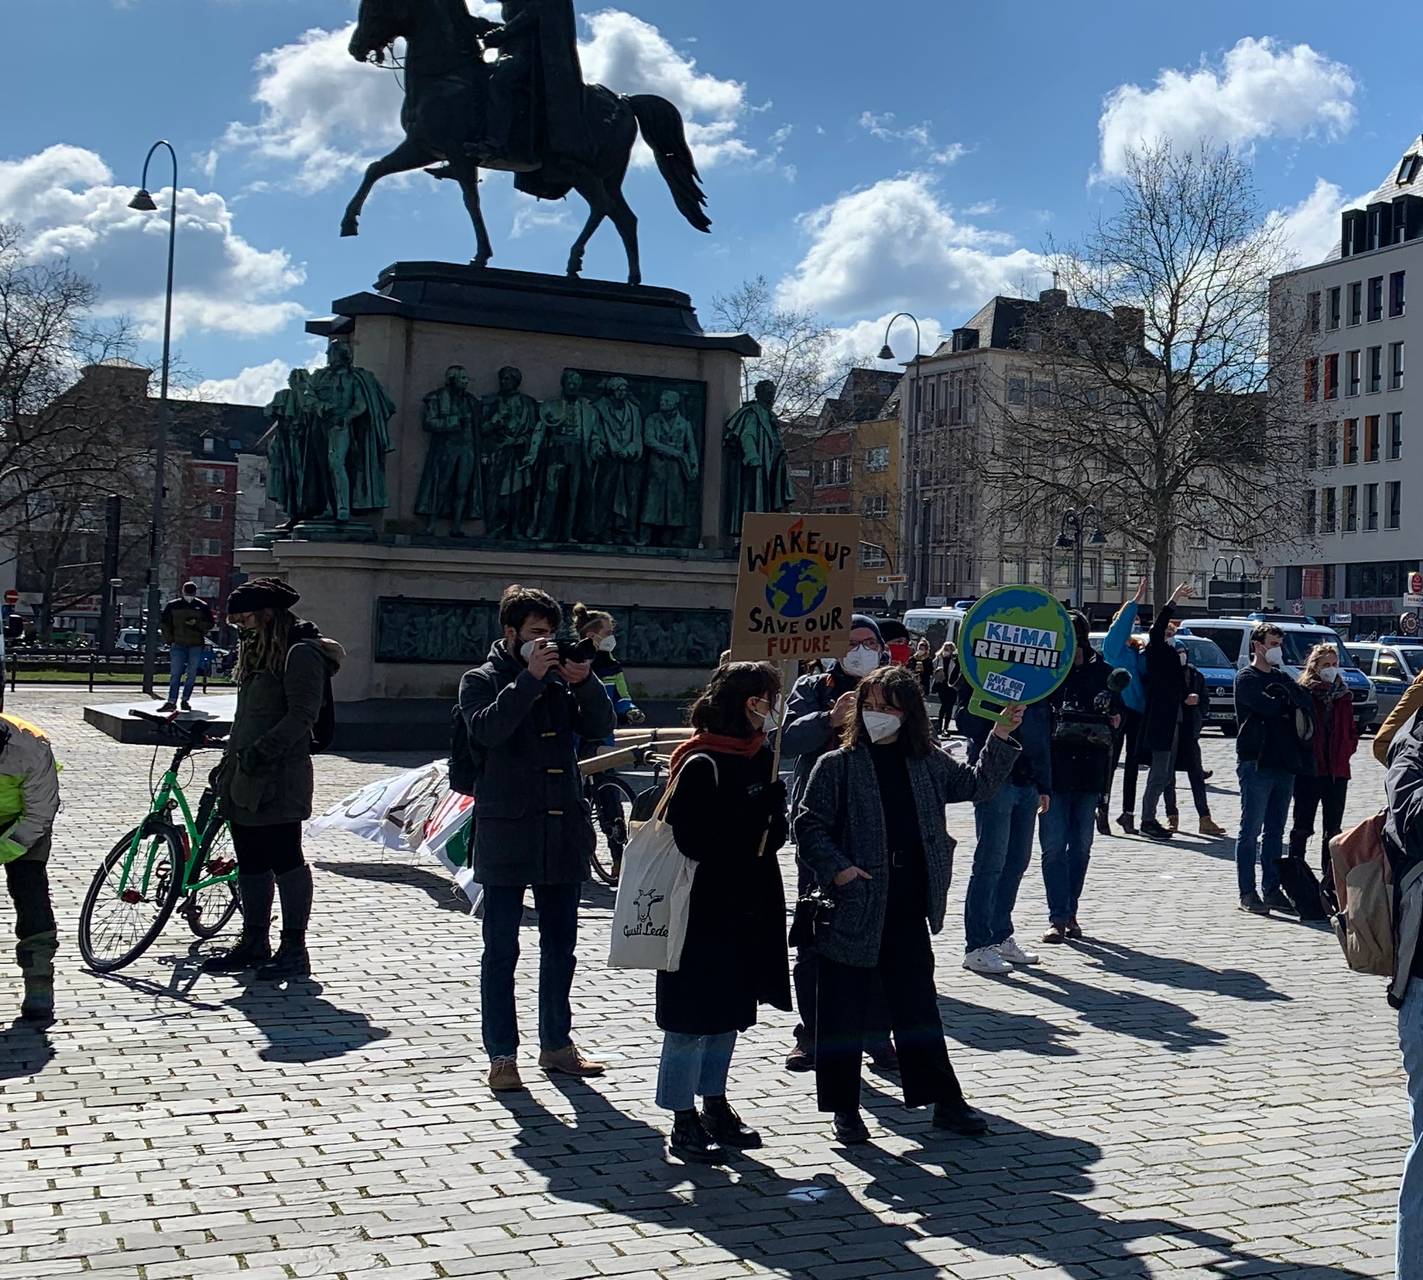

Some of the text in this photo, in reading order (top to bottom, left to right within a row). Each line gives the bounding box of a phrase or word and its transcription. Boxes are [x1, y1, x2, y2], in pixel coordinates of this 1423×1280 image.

[747, 530, 851, 572] WAKE UP
[748, 607, 843, 634] SAVE OUR
[767, 635, 831, 656] FUTURE
[974, 640, 1059, 668] RETTEN!
[986, 681, 1020, 698] PLANET
[643, 921, 669, 938] Lede
